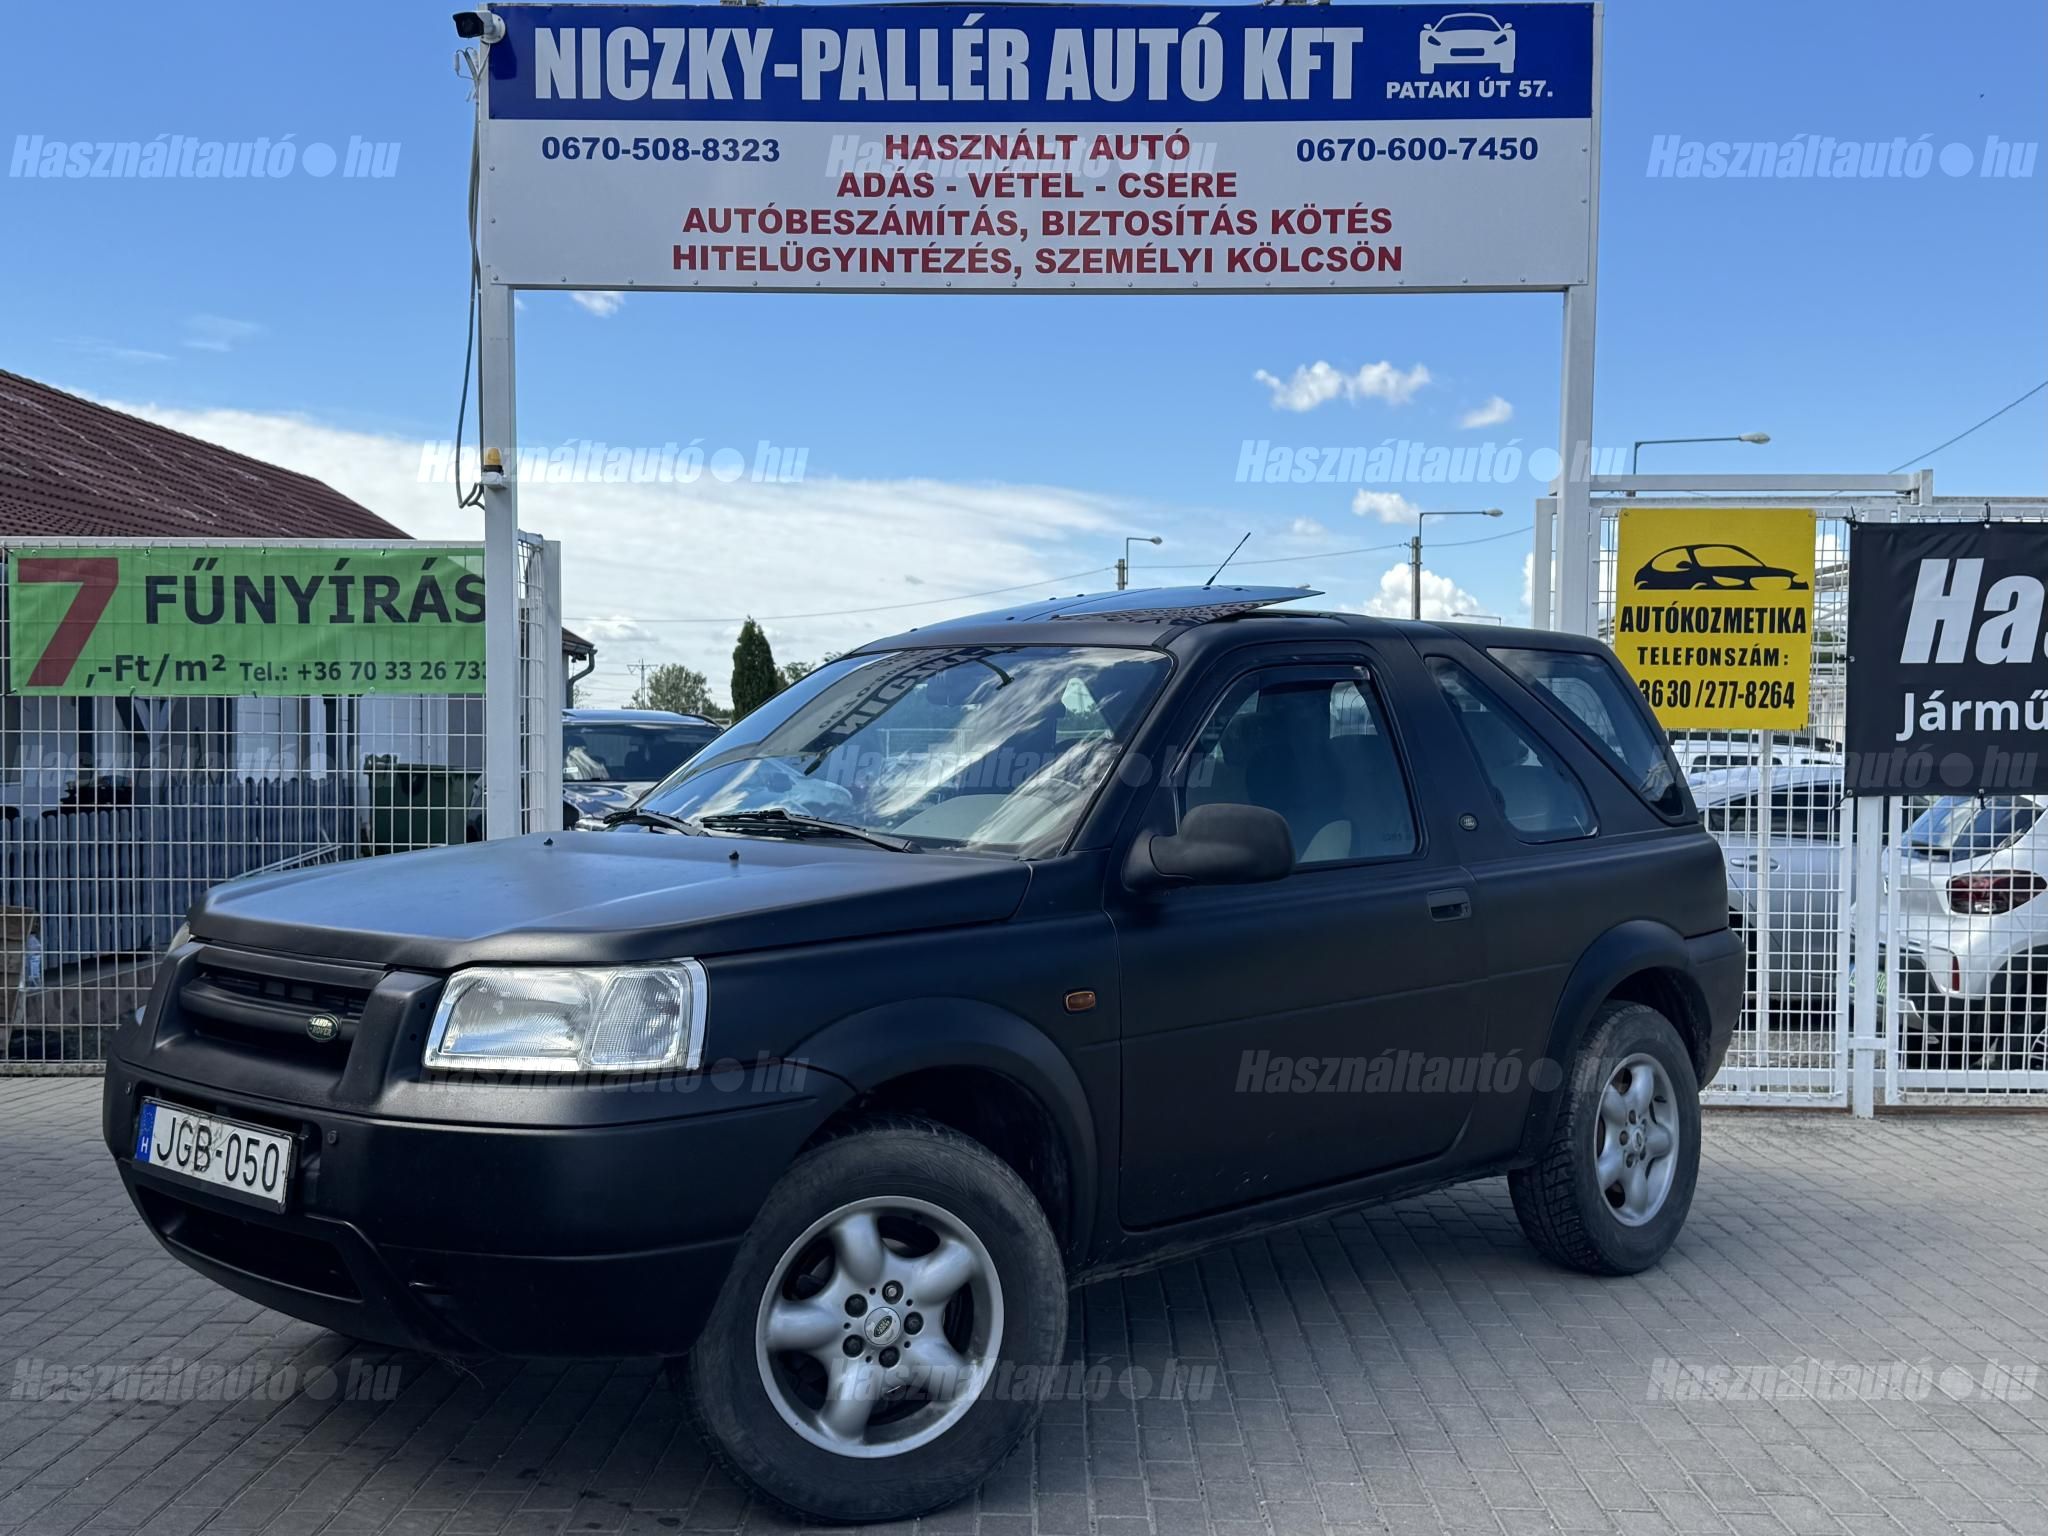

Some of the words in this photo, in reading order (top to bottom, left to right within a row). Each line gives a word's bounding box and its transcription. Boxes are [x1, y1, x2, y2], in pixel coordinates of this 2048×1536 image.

[535, 13, 1030, 101] NICZKY-PALLÉR
[1046, 13, 1224, 101] AUTÓ
[1243, 26, 1364, 100] KFT
[1385, 80, 1470, 99] PATAKI
[1478, 76, 1511, 98] ÚT
[1518, 79, 1554, 98] 57.
[541, 136, 780, 162] 0670-508-8323
[885, 128, 1078, 161] HASZNÁLT
[1089, 128, 1190, 161] AUTÓ
[1296, 136, 1539, 162] 0670-600-7450
[837, 166, 935, 198] ADÁS
[968, 166, 1084, 198] VÉTEL
[1118, 172, 1237, 198] CSERE
[682, 202, 1028, 240] AUTÓBESZÁMÍTÁS,
[1042, 202, 1258, 236] BIZTOSÍTÁS
[1271, 202, 1393, 235] KÖTÉS
[673, 240, 1022, 278] HITELÜGYINTÉZÉS,
[1035, 242, 1213, 274] SZEMÉLYI
[1227, 241, 1403, 274] KÖLCSÖN
[145, 556, 486, 624] FŰNYÍRÁS
[17, 556, 119, 687] 7
[1619, 601, 1807, 634] AUTÓKOZMETIKA
[1900, 557, 2048, 665] Ha
[239, 661, 288, 682] Tel.:
[297, 661, 342, 681] +36
[350, 661, 377, 681] 70
[384, 661, 412, 681] 33
[420, 661, 447, 681] 26
[454, 661, 486, 681] 73
[1637, 643, 1789, 666] TELEFONSZÁM:
[1895, 689, 2048, 742] Jármű
[156, 1116, 280, 1192] JGB-050
